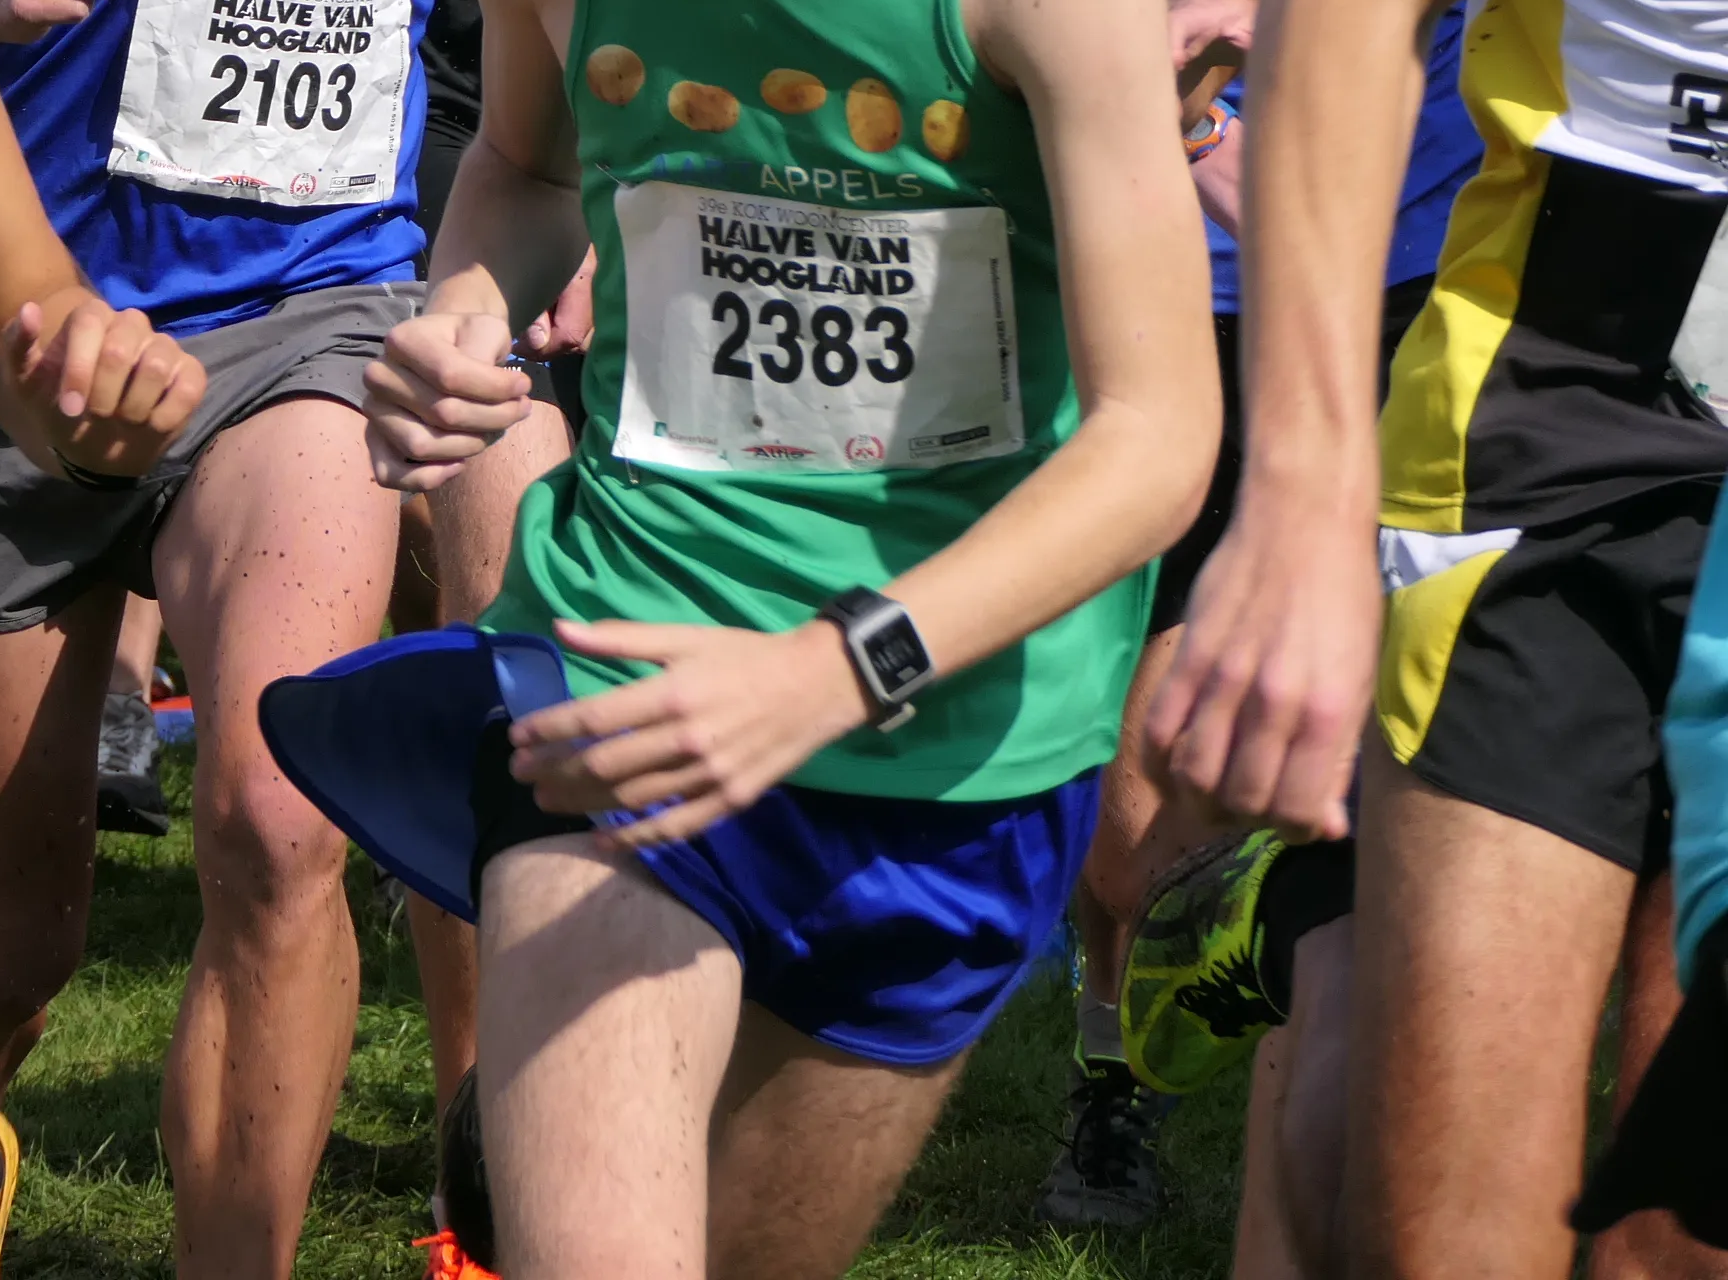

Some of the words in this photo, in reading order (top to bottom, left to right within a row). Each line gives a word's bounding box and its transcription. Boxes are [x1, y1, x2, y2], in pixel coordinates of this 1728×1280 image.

[208, 18, 371, 54] HOOGLAND
[324, 4, 374, 28] VAN
[201, 54, 358, 132] 2103
[698, 196, 727, 213] 39e
[732, 200, 771, 221] KOK
[777, 207, 911, 234] WOONCENTER
[699, 214, 817, 258] HALVE
[825, 232, 910, 264] VAN
[702, 246, 915, 296] HOOGLAND
[712, 290, 915, 387] 2383
